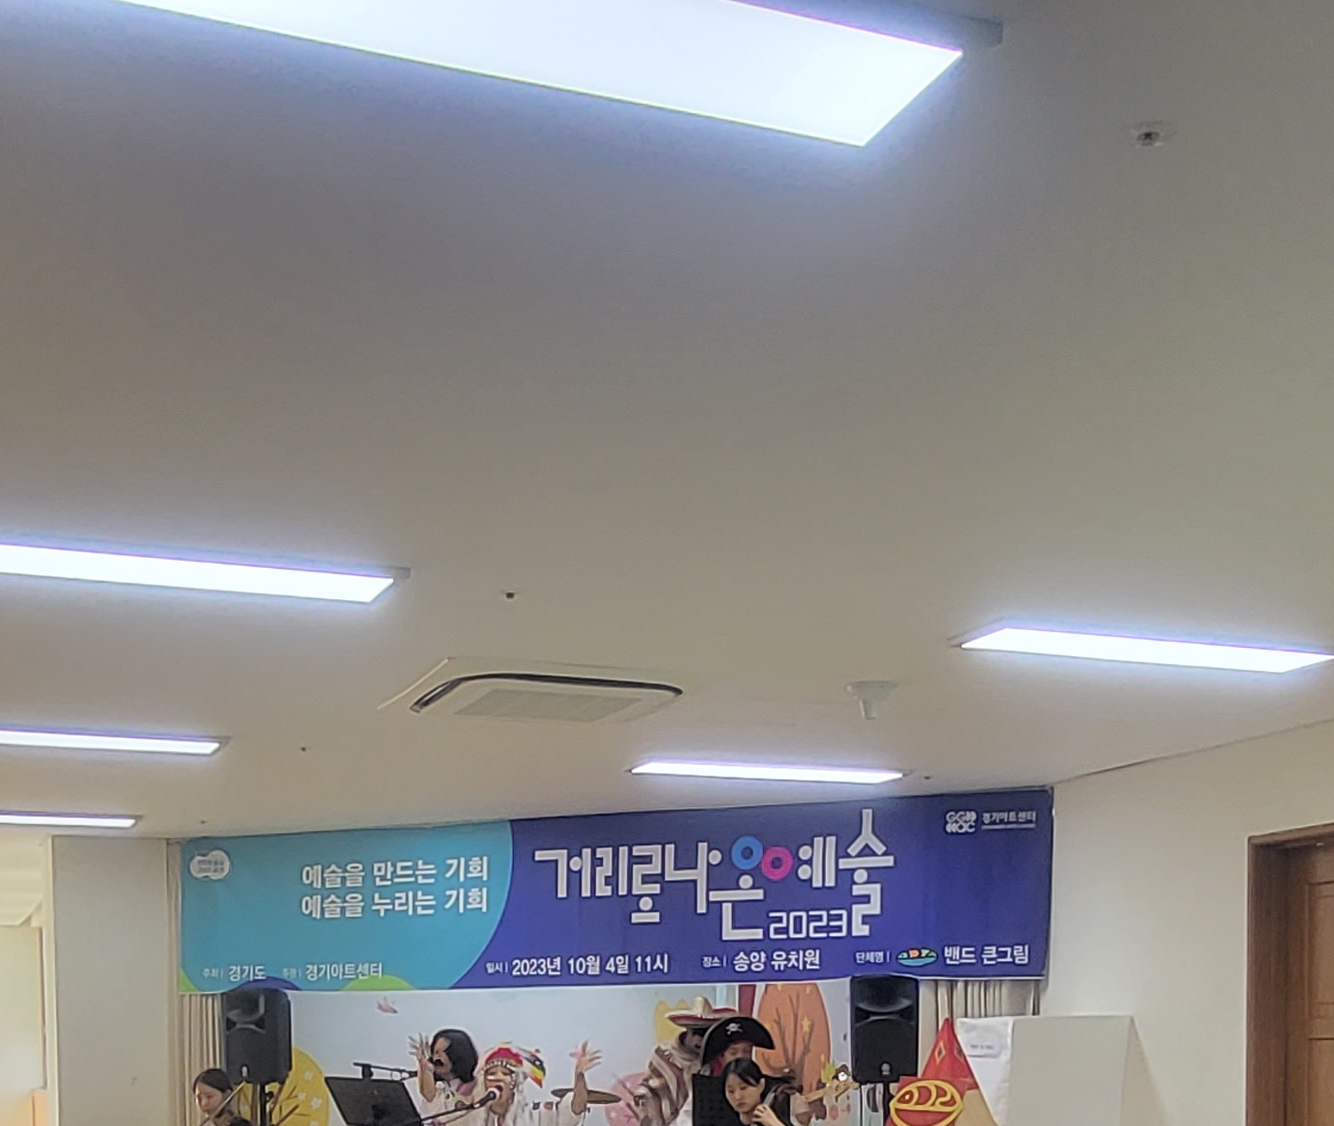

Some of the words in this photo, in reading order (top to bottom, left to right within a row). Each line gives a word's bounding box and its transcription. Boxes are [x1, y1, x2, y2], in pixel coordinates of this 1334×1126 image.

[982, 811, 1036, 824] 경기아트센터
[301, 863, 365, 889] 예술을
[373, 860, 437, 886] 만드는
[444, 856, 488, 882] 기회
[301, 893, 365, 919] 예술을
[371, 890, 436, 917] 누리는
[444, 887, 487, 914] 기회
[769, 909, 849, 939] 2023
[512, 956, 561, 976] 2023년
[568, 955, 601, 975] 10월
[605, 954, 629, 974] 4일
[635, 952, 669, 974] 11시
[702, 955, 722, 968] 장소
[732, 951, 765, 972] 송양
[771, 949, 821, 971] 유치원
[944, 946, 977, 965] 밴드
[982, 944, 1029, 965] 큰그림
[228, 965, 266, 981] 경기도
[305, 962, 383, 982] 경기아트센터
